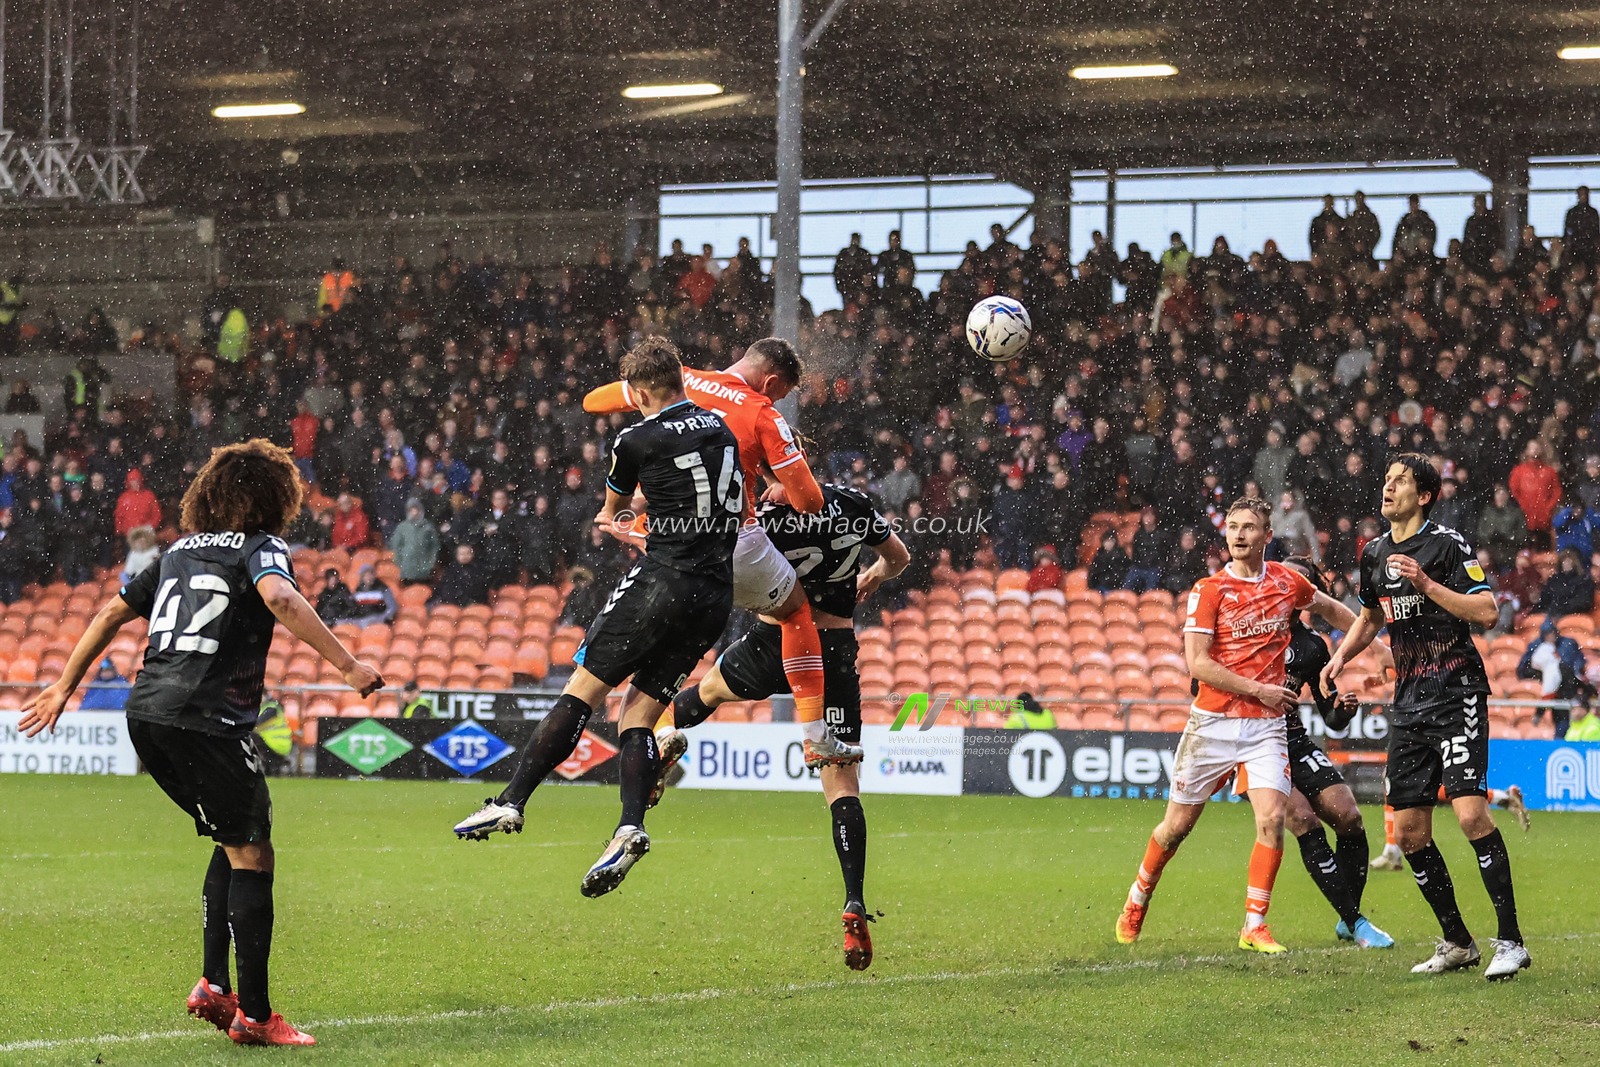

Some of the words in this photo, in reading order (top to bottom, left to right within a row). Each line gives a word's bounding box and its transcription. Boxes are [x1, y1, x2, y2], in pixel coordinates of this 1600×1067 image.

[684, 375, 748, 405] MADINE
[673, 415, 720, 434] PRING
[673, 446, 743, 518] 16
[783, 533, 862, 582] 22
[1391, 594, 1425, 605] MANSION
[1393, 602, 1424, 621] BET
[148, 573, 231, 655] 42
[1231, 617, 1255, 631] VISIT
[349, 733, 387, 759] FTS
[449, 735, 488, 761] FTS
[1440, 735, 1471, 770] 25
[12, 754, 39, 774] TO
[48, 755, 117, 775] TRADE
[699, 740, 770, 779] Blue
